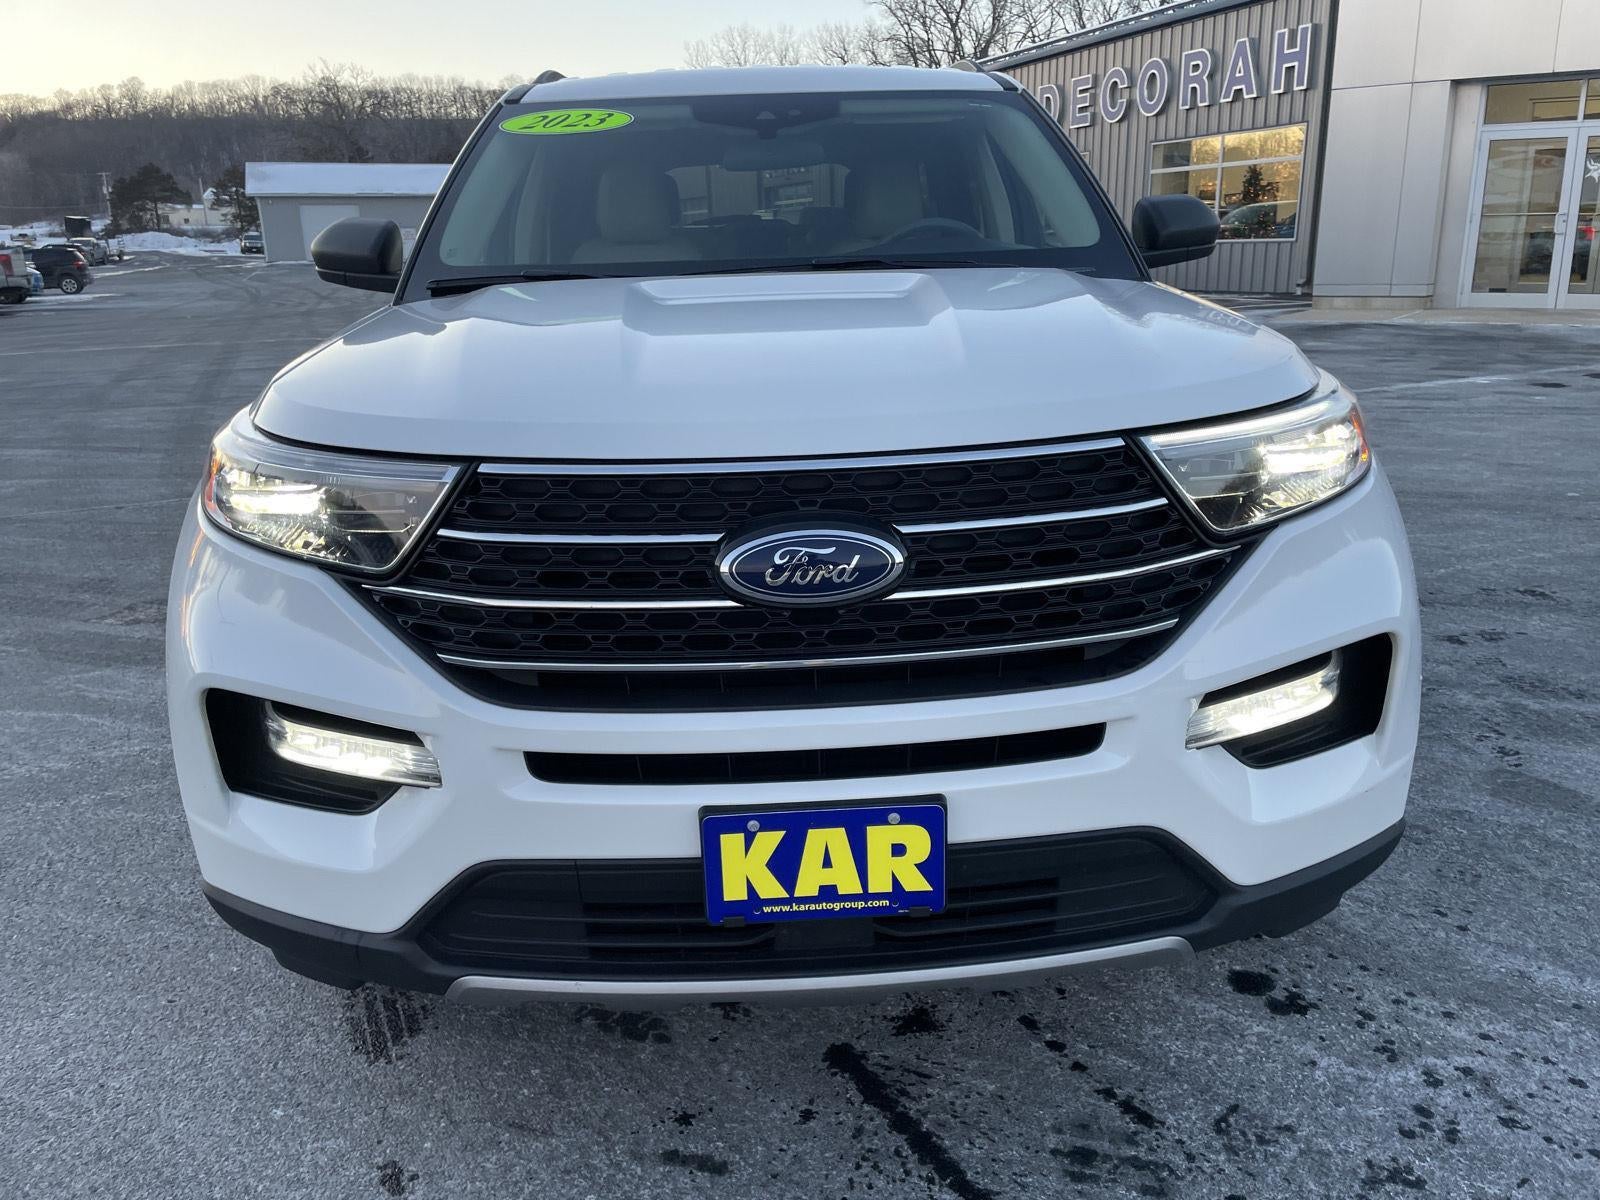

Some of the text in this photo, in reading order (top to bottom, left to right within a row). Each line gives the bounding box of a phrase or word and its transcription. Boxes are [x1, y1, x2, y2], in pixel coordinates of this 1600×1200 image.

[1039, 23, 1312, 129] DECORAH
[518, 112, 615, 130] 2023
[765, 546, 861, 586] Ford
[719, 824, 934, 902] KAR
[762, 898, 890, 914] www.karautogroup.com
